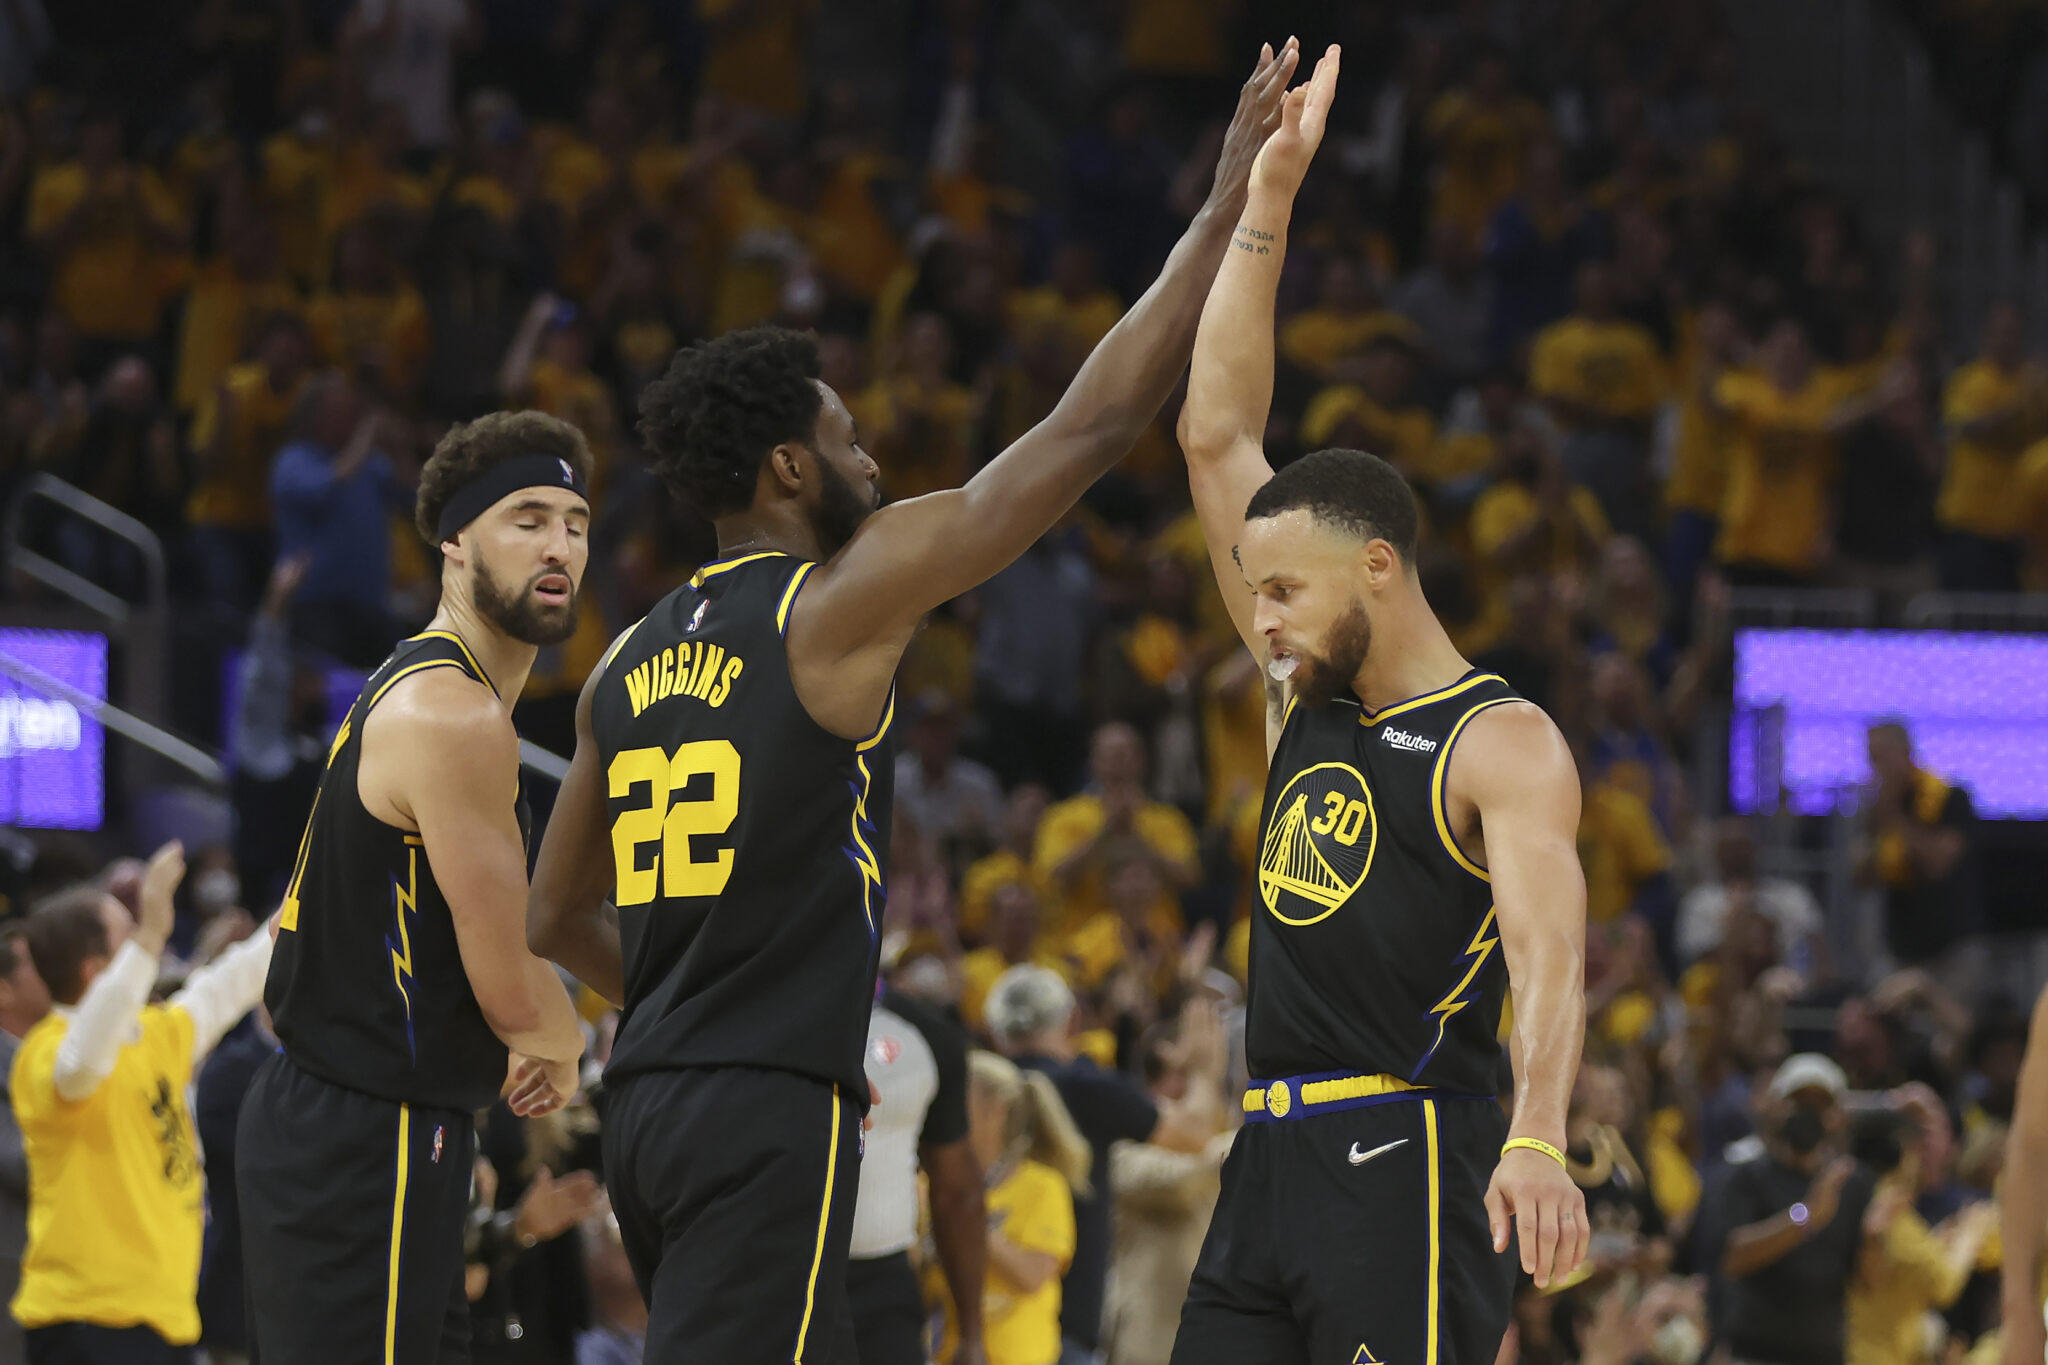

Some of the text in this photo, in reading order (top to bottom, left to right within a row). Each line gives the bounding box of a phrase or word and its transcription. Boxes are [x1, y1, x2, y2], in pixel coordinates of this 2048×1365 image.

[625, 641, 744, 718] WIGGINS
[1381, 726, 1437, 753] Rakuten
[607, 739, 741, 907] 22
[1311, 790, 1367, 846] 30
